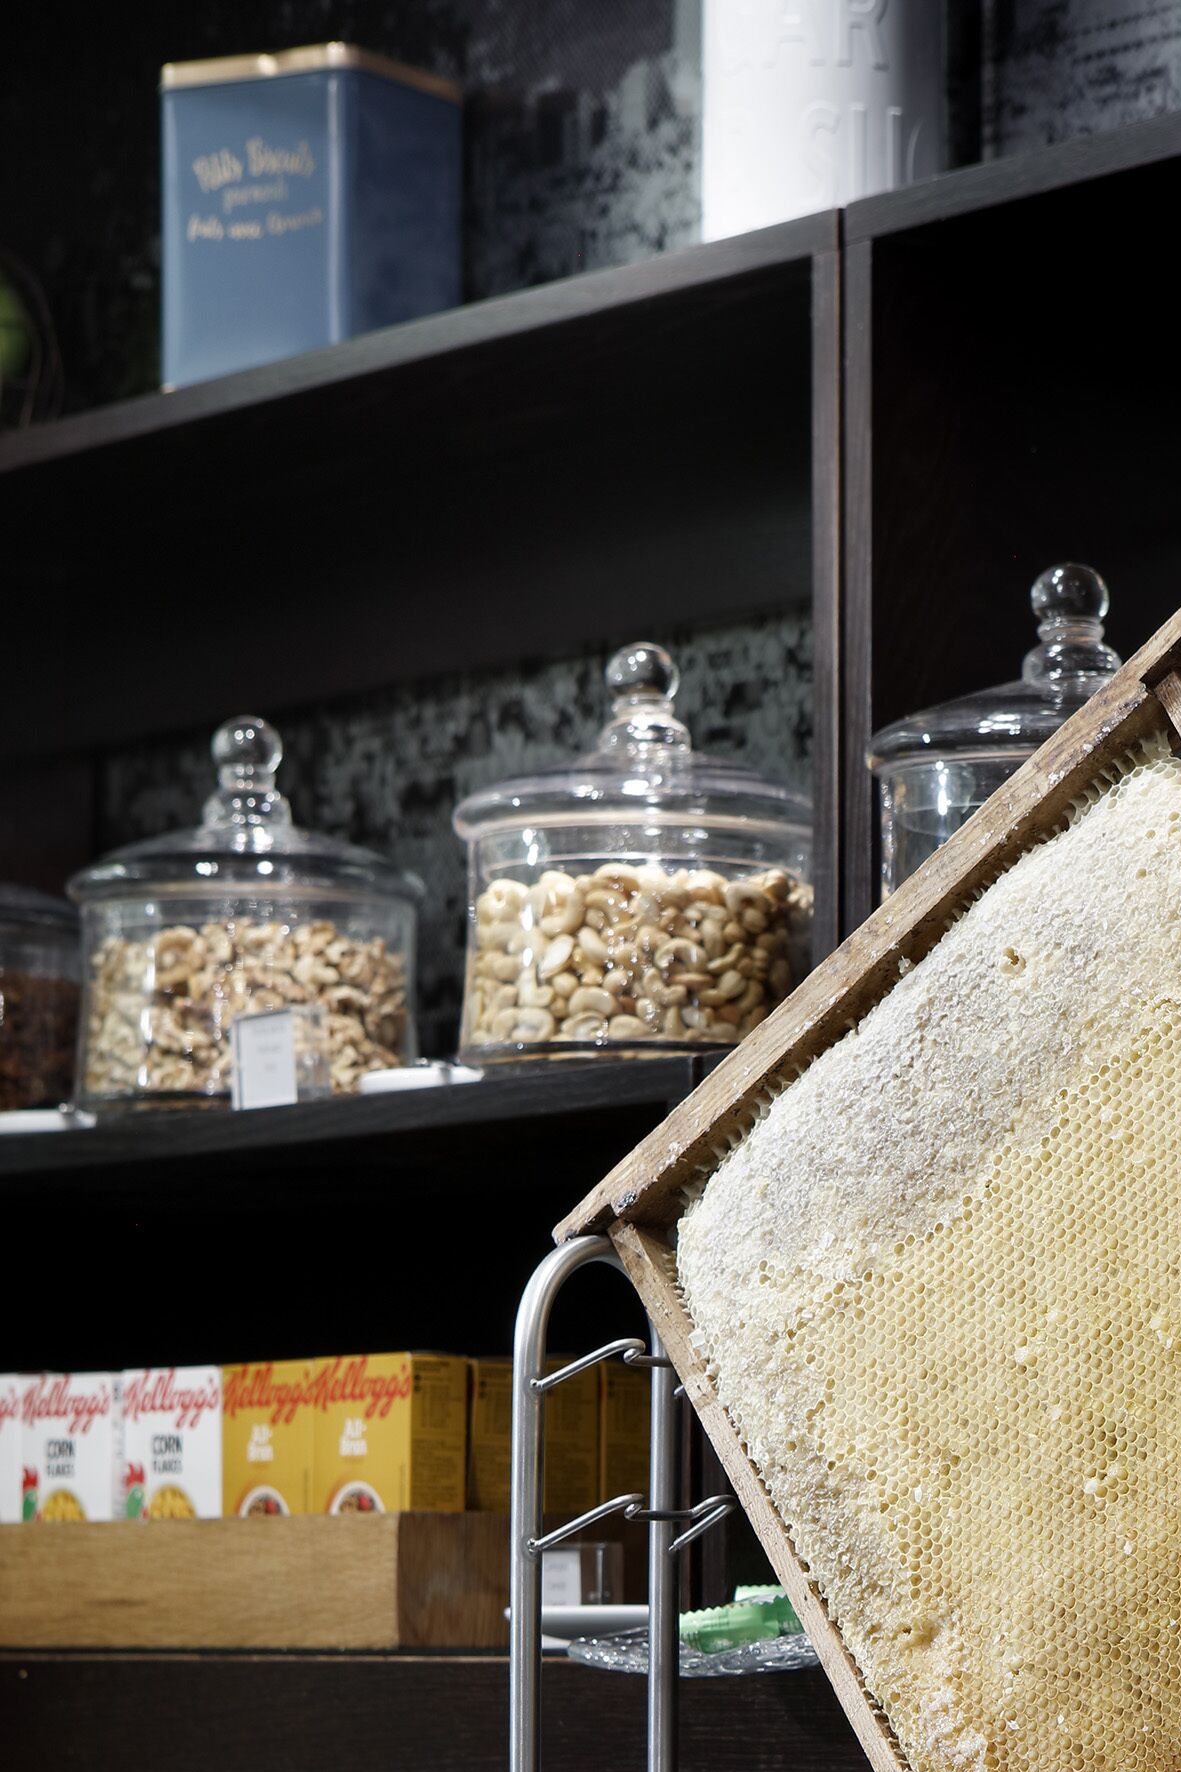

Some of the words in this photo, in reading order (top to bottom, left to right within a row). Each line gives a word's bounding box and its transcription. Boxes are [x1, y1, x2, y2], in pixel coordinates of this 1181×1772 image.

[21, 1375, 110, 1434] Kellogg's
[122, 1368, 220, 1429] Kellogg's
[223, 1363, 314, 1425] Kellogg's
[313, 1355, 412, 1420] Kellogg's
[47, 1439, 76, 1459] CORN
[152, 1434, 183, 1455] CORN
